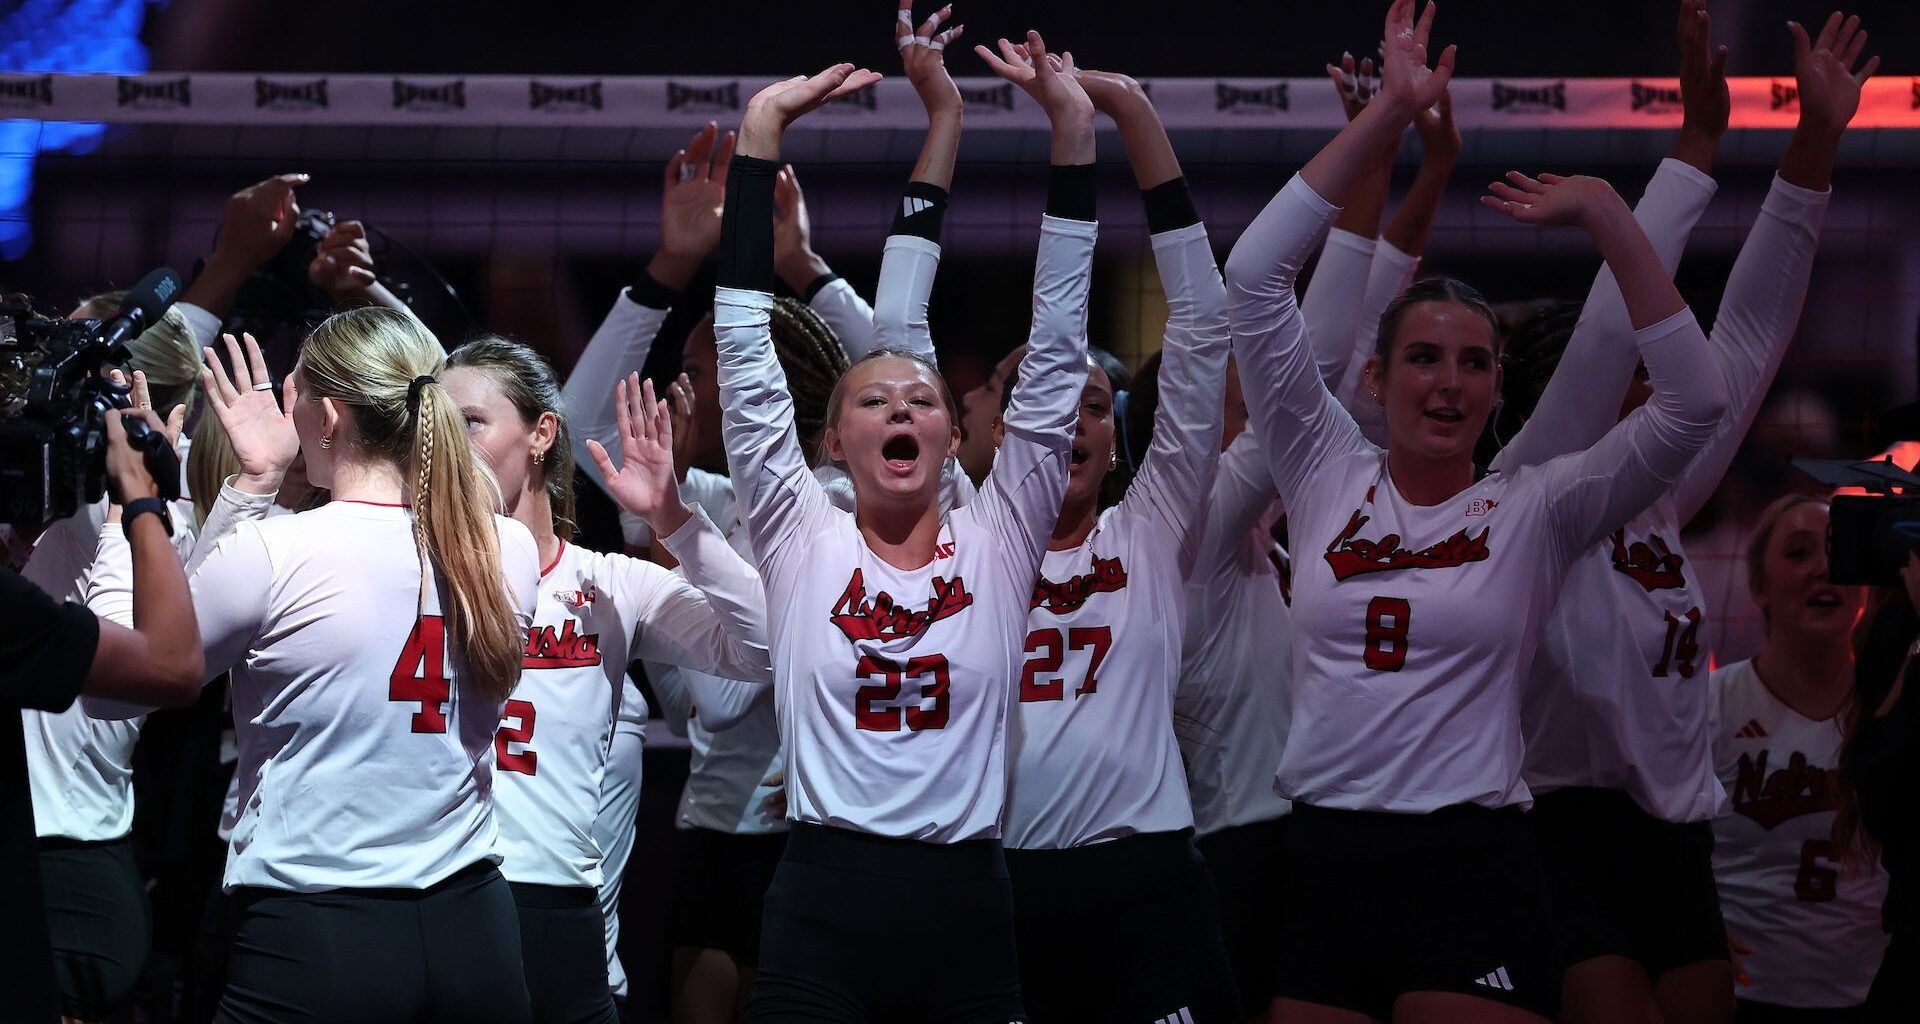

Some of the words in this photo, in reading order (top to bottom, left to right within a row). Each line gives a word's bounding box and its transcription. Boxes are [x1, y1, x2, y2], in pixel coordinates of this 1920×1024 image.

[117, 76, 191, 107] SPIKES
[256, 78, 328, 108] SPIKES
[393, 79, 466, 109] SPIKES
[530, 80, 603, 109] SPIKES
[667, 82, 740, 110] SPIKES
[1216, 83, 1289, 111] SPIKES
[1492, 83, 1566, 111] SPIKES
[1363, 596, 1411, 672] 8
[1652, 606, 1701, 679] 14
[388, 614, 451, 734] 4
[1019, 625, 1113, 703] 27
[855, 653, 951, 731] 23
[494, 699, 537, 776] 2
[1794, 839, 1840, 902] 6
